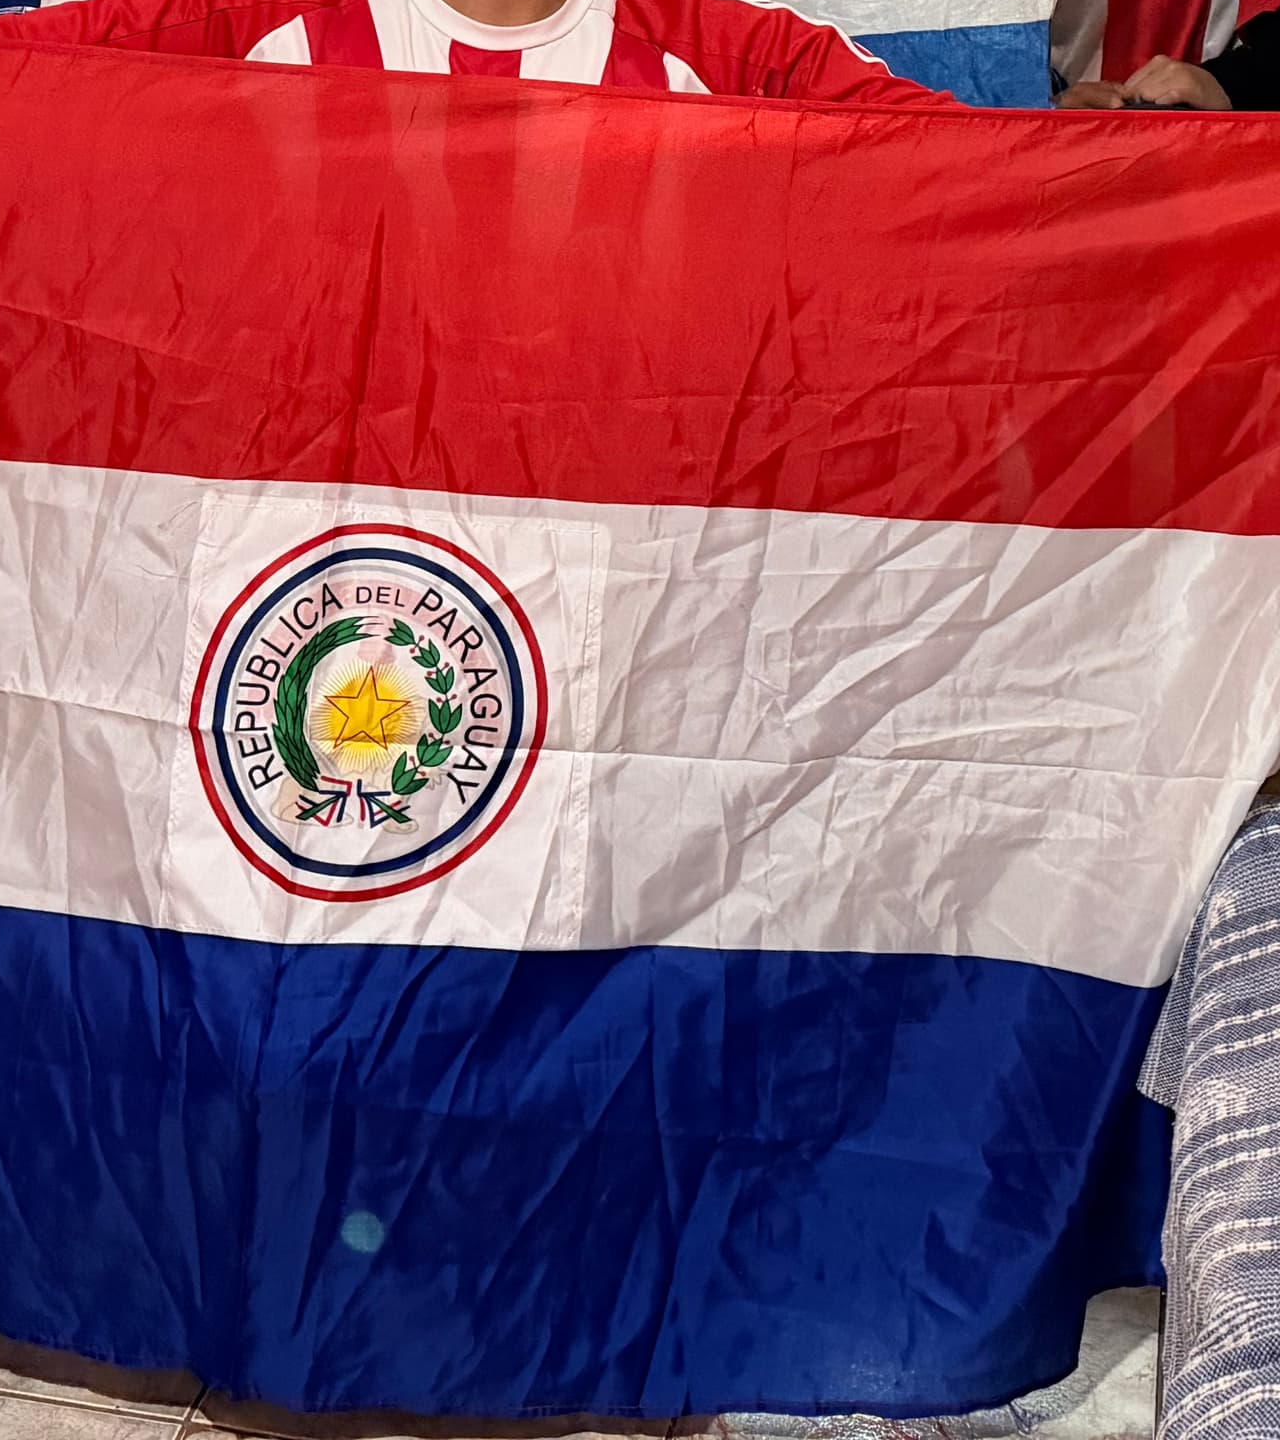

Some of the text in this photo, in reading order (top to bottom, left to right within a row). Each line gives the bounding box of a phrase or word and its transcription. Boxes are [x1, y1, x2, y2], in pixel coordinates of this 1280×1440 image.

[234, 582, 503, 805] REPUBLICA DEL PARAGUAY
